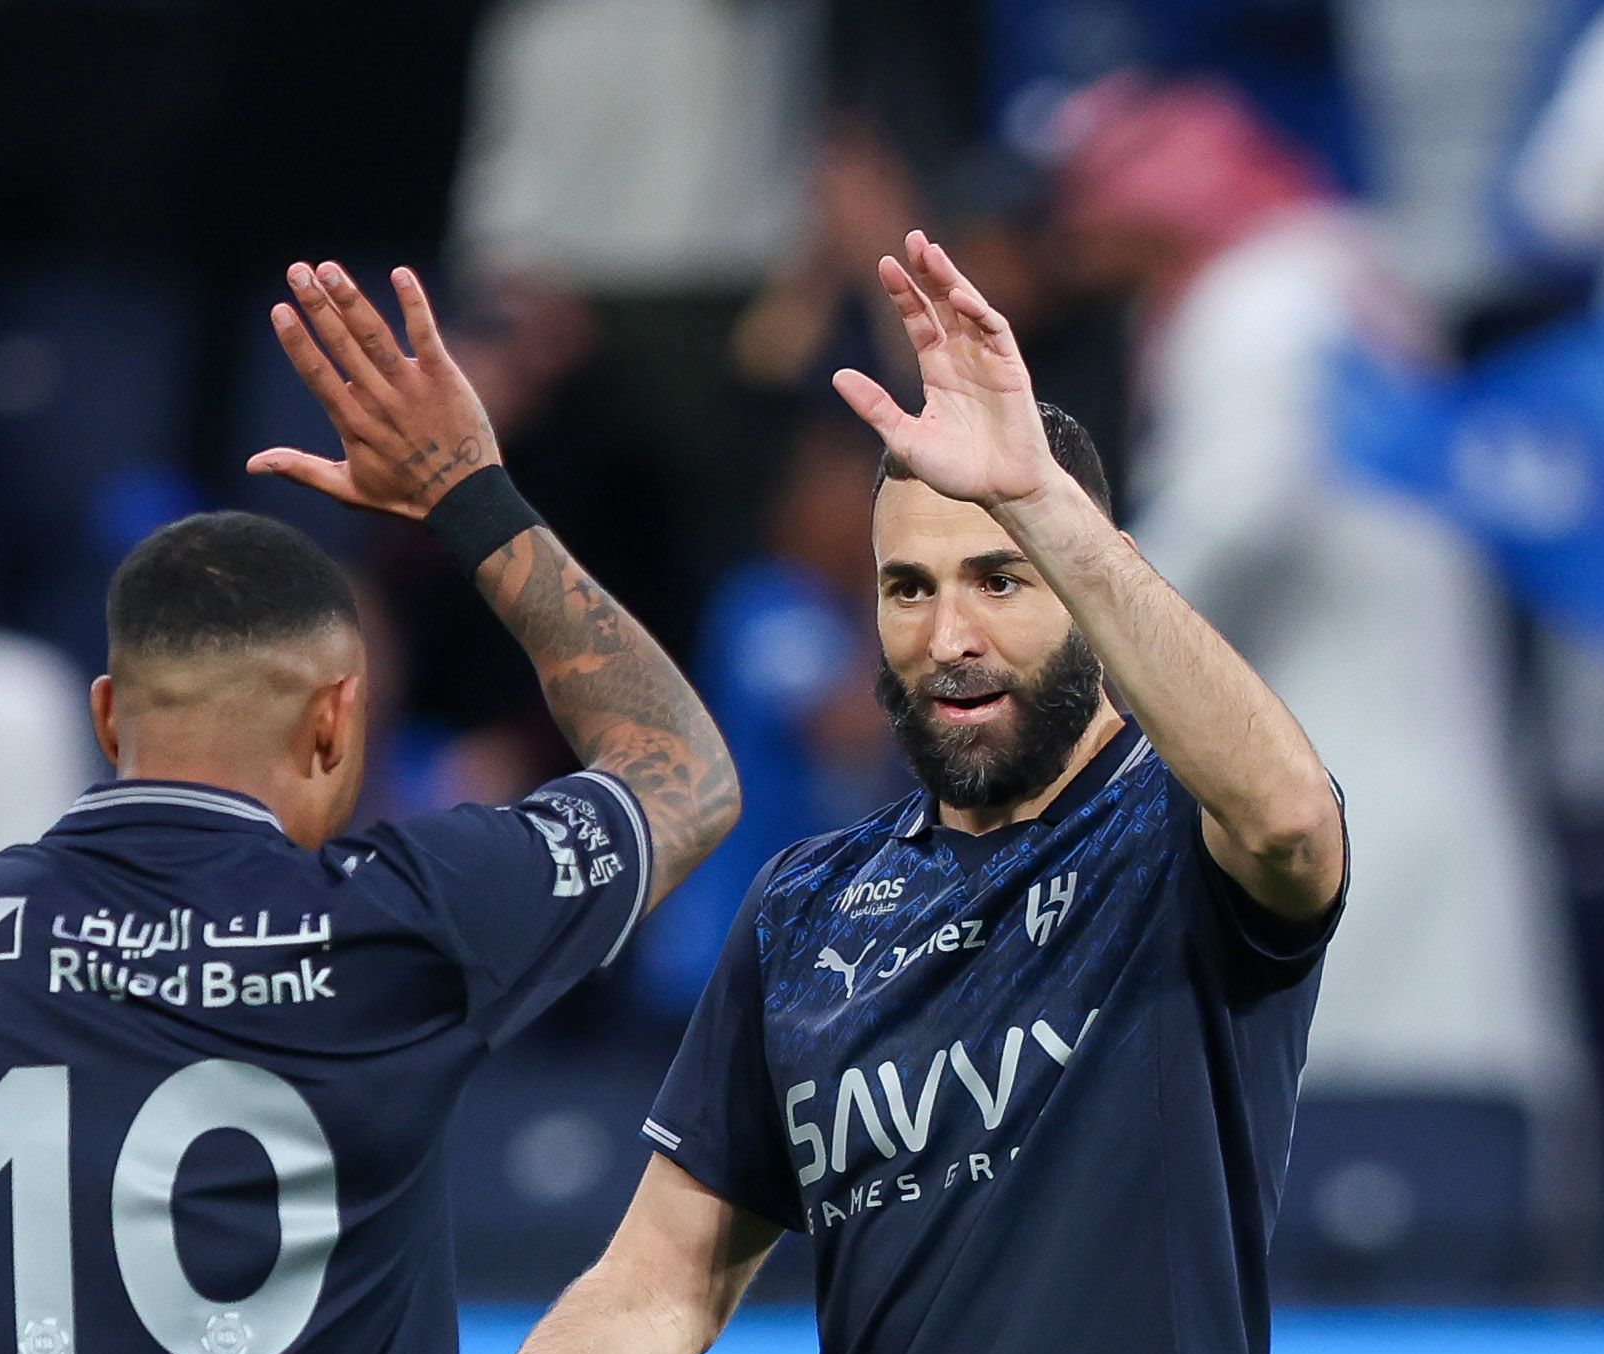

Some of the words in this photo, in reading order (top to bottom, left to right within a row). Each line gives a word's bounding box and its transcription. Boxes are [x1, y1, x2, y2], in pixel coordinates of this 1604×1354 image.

[51, 907, 194, 959] الرياض
[48, 946, 189, 1007] Riyad
[201, 957, 336, 1009] Bank
